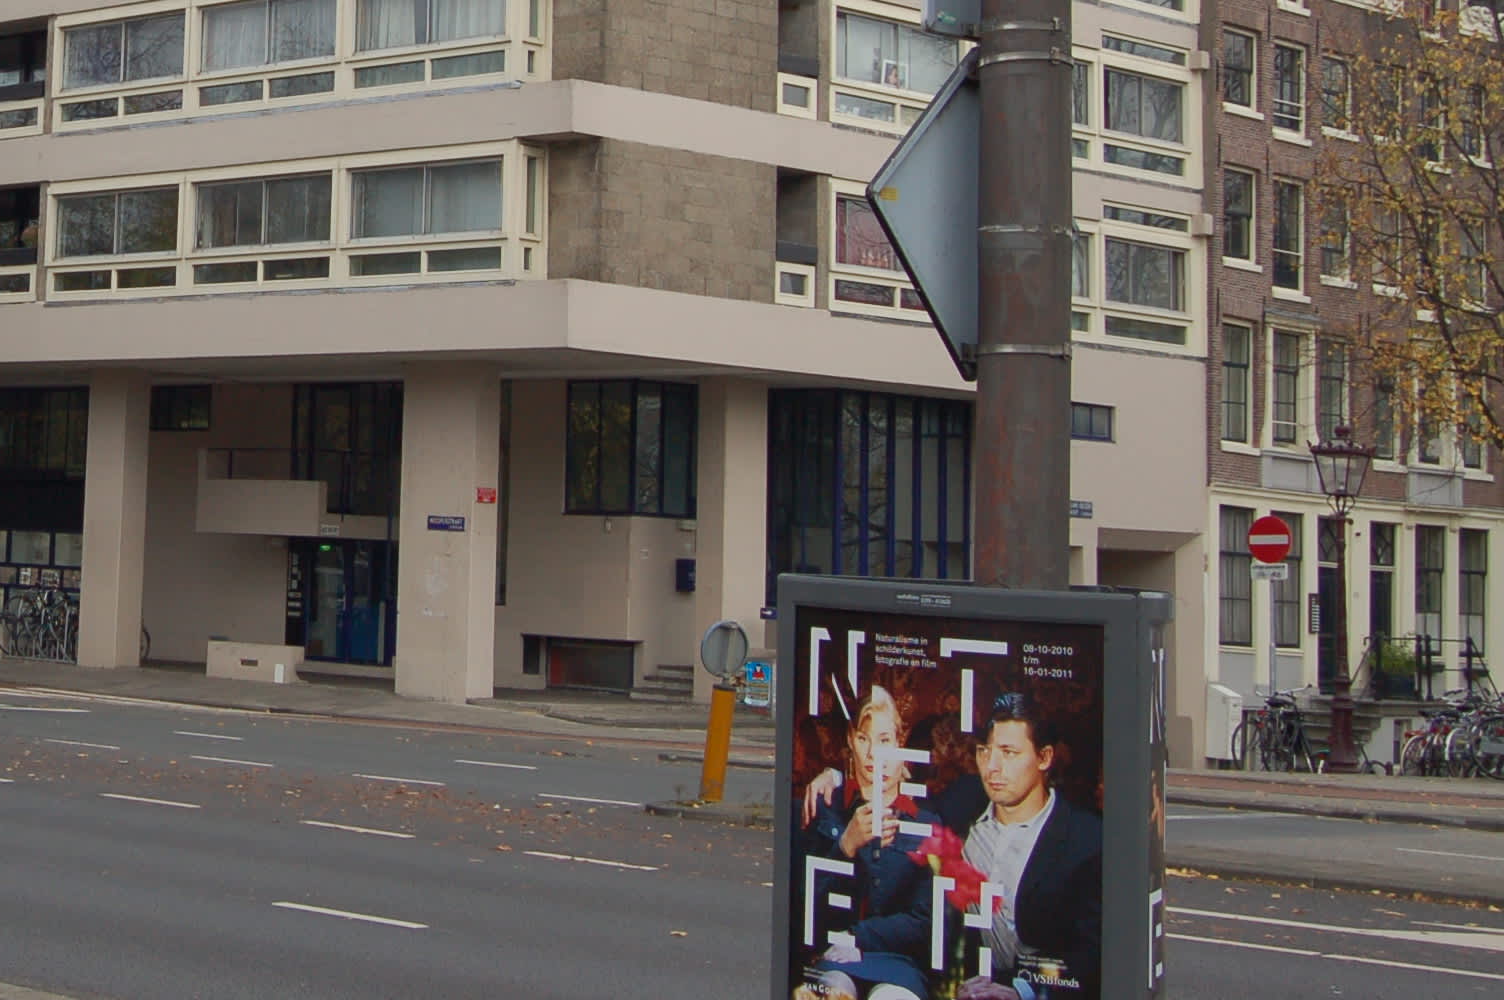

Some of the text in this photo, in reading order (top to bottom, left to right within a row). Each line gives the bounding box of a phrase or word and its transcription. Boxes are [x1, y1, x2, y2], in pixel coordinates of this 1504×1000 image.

[920, 637, 928, 646] in
[1023, 643, 1073, 656] 08-10-2010
[921, 657, 937, 668] film
[1023, 656, 1039, 665] t/m
[1023, 667, 1073, 679] 16-01-2011
[1033, 973, 1080, 988] VSBfonds
